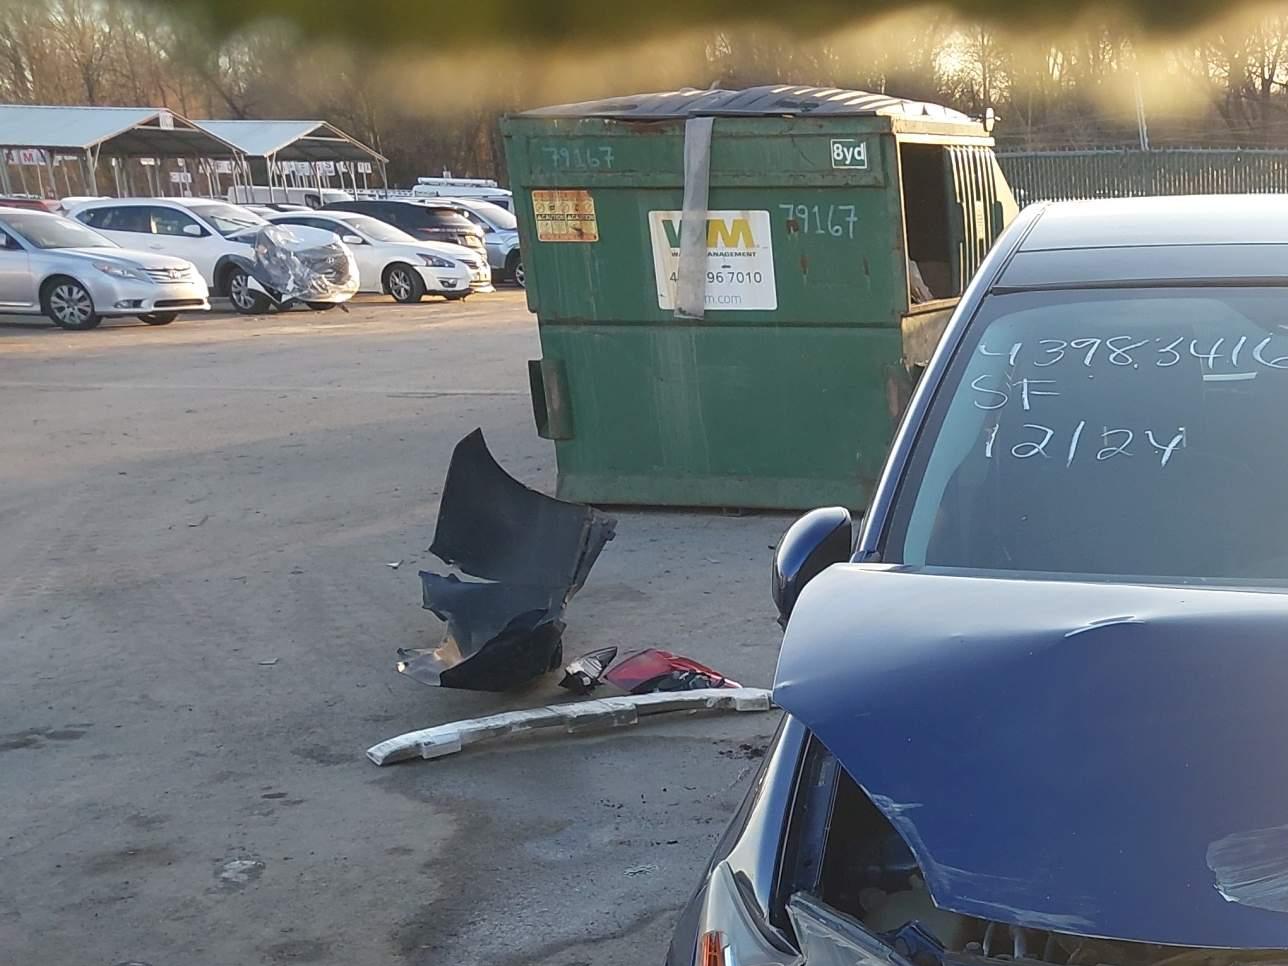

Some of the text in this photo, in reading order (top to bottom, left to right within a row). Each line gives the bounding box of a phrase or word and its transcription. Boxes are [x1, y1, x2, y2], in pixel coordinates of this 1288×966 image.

[542, 146, 615, 168] 79167
[833, 143, 865, 165] 8yd
[779, 204, 858, 239] 79167
[728, 271, 762, 284] 7010
[971, 374, 1061, 411] SF
[984, 420, 1186, 468] 12/24
